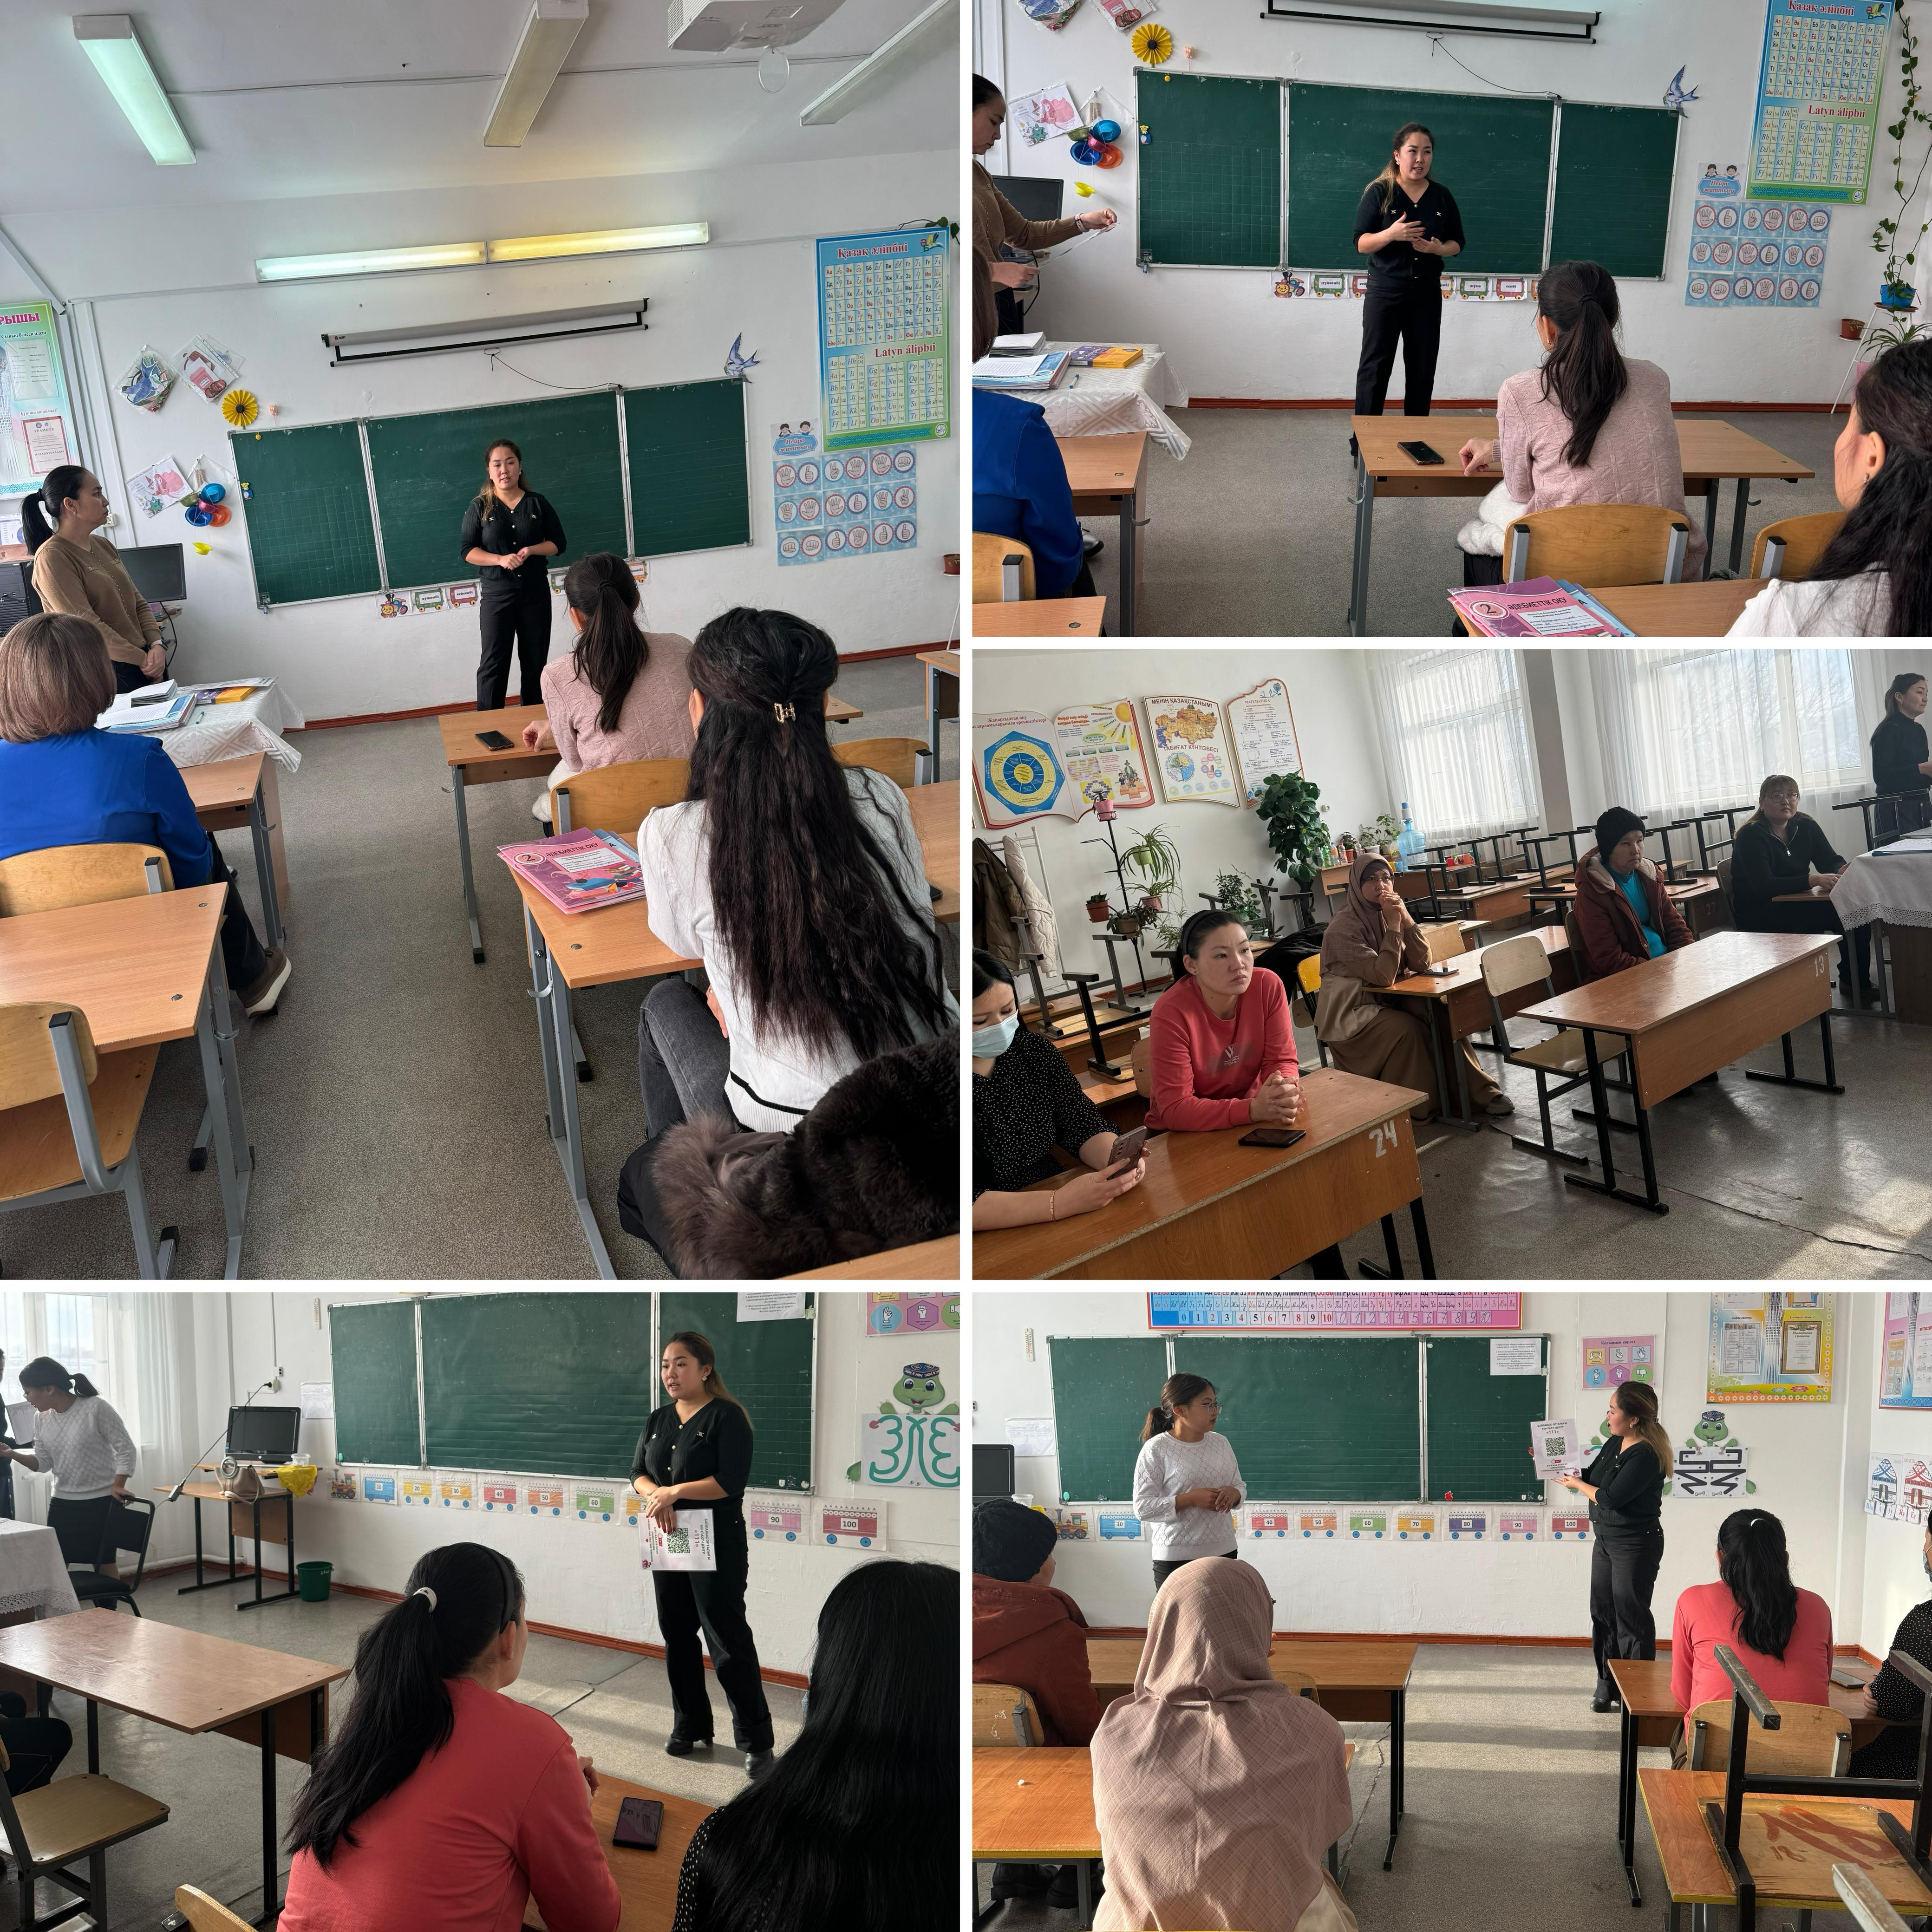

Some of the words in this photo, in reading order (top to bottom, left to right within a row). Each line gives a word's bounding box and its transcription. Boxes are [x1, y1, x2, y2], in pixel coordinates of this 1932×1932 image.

[1788, 0, 1818, 13] Қазақ
[1820, 4, 1854, 16] әліпбиі
[1808, 105, 1834, 118] Latyn
[838, 248, 868, 259] Қазақ
[871, 242, 907, 255] әліпбиі
[875, 348, 902, 358] Latyn
[1480, 604, 1496, 614] 2
[1508, 600, 1552, 610] ӘДЕБИЕТТІК
[1170, 698, 1212, 708] ҚАЗАҚСТАНЫМ!
[546, 846, 585, 857] ӘДЕБИЕТТІК
[1815, 955, 1824, 977] 13
[1369, 1119, 1397, 1158] 24
[1340, 1312, 1346, 1323] 0
[1355, 1312, 1361, 1323] 1
[1369, 1313, 1375, 1323] 2
[1384, 1312, 1390, 1323] 3
[1398, 1312, 1403, 1323] 4
[1412, 1312, 1418, 1323] 5
[1427, 1312, 1433, 1323] 6
[1442, 1312, 1447, 1323] 7
[1456, 1312, 1461, 1323] 8
[1470, 1312, 1476, 1323] 9
[1481, 1312, 1490, 1323] 10
